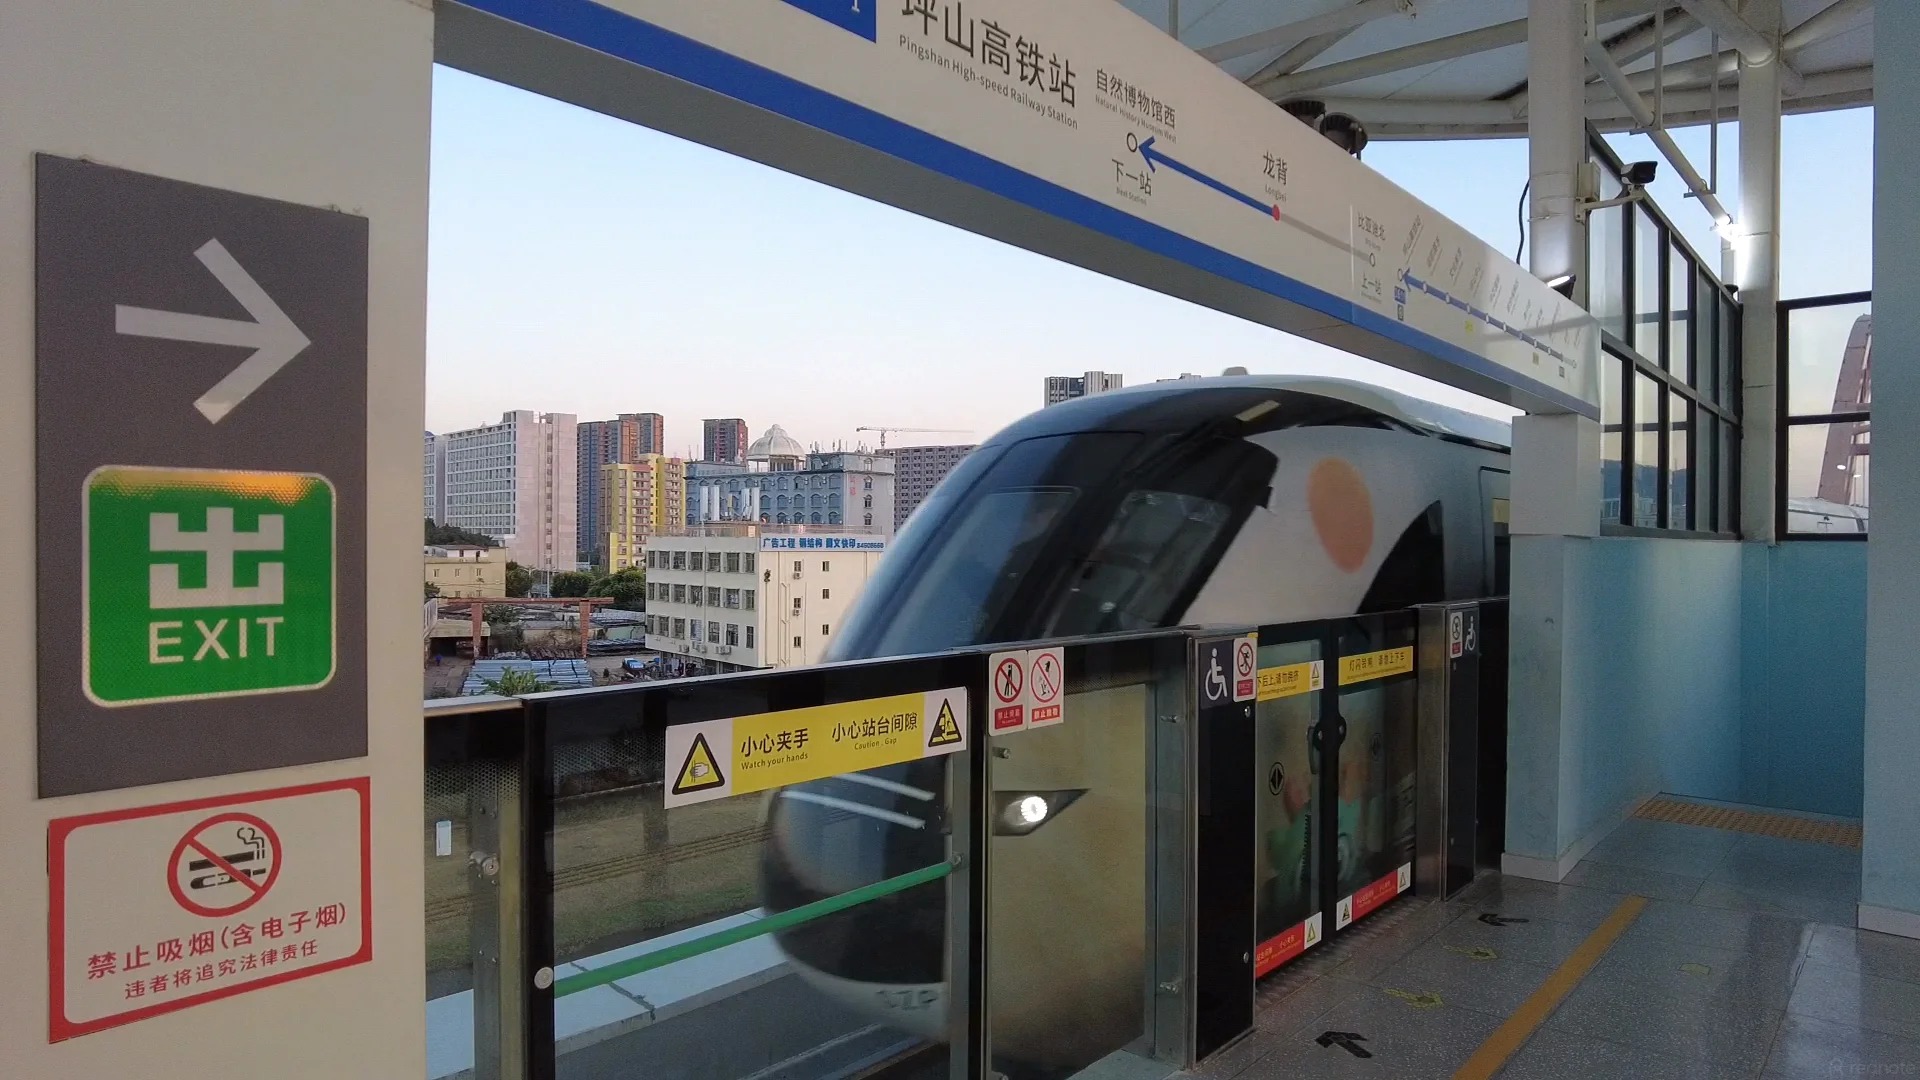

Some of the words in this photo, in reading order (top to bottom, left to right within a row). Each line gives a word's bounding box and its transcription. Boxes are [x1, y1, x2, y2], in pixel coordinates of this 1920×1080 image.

[899, 34, 950, 69] Pingshan
[952, 59, 1008, 97] High-speed
[1010, 87, 1046, 116] Railway
[1047, 106, 1078, 129] Station
[1097, 68, 1175, 129] 自然博物馆西
[1112, 158, 1151, 196] 下一站
[1263, 151, 1288, 185] 龙背
[763, 537, 796, 549] 广告工程
[149, 616, 285, 664] EXIT
[741, 728, 809, 758] 小心夹手
[832, 712, 918, 743] 小心站台间隙
[854, 740, 880, 751] Caution
[884, 737, 897, 746] Gap
[741, 759, 766, 771] Watch
[767, 756, 785, 769] your
[786, 752, 808, 763] hands
[87, 902, 347, 980] 禁止吸烟(含电子烟)
[124, 938, 318, 1000] 违者将追究法律责任
